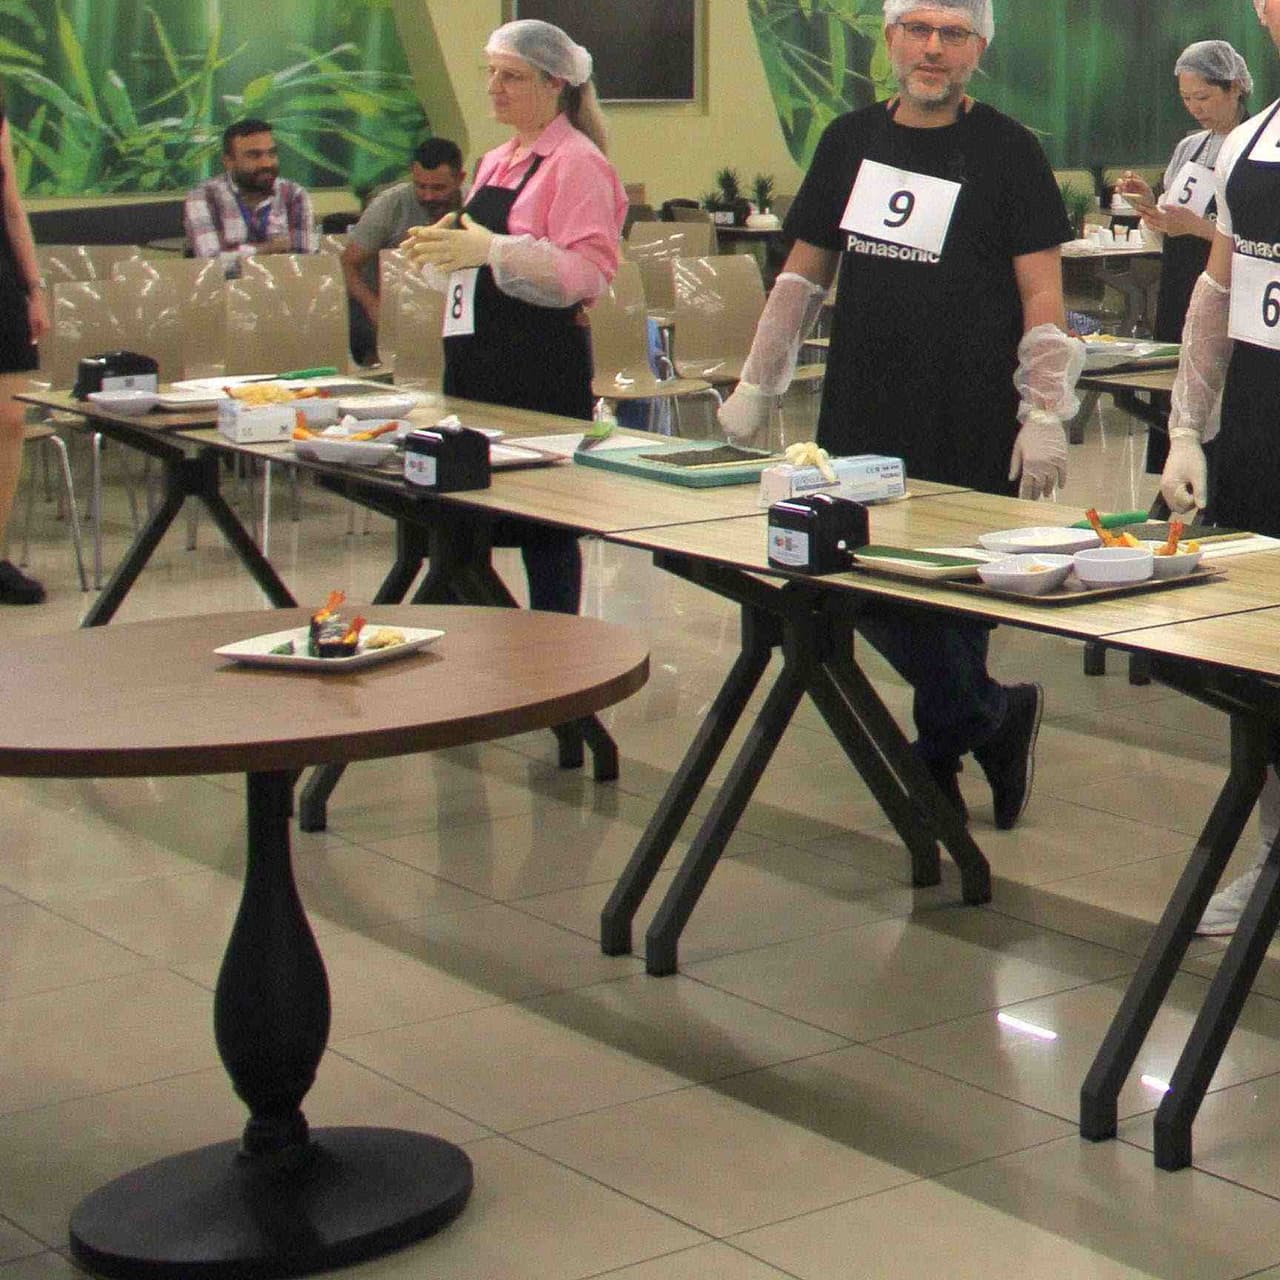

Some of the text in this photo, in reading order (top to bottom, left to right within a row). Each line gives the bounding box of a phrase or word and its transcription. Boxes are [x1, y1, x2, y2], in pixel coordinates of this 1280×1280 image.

[1178, 176, 1197, 204] 5
[884, 190, 915, 227] 9
[847, 234, 940, 263] Panasonic
[452, 283, 463, 319] 8
